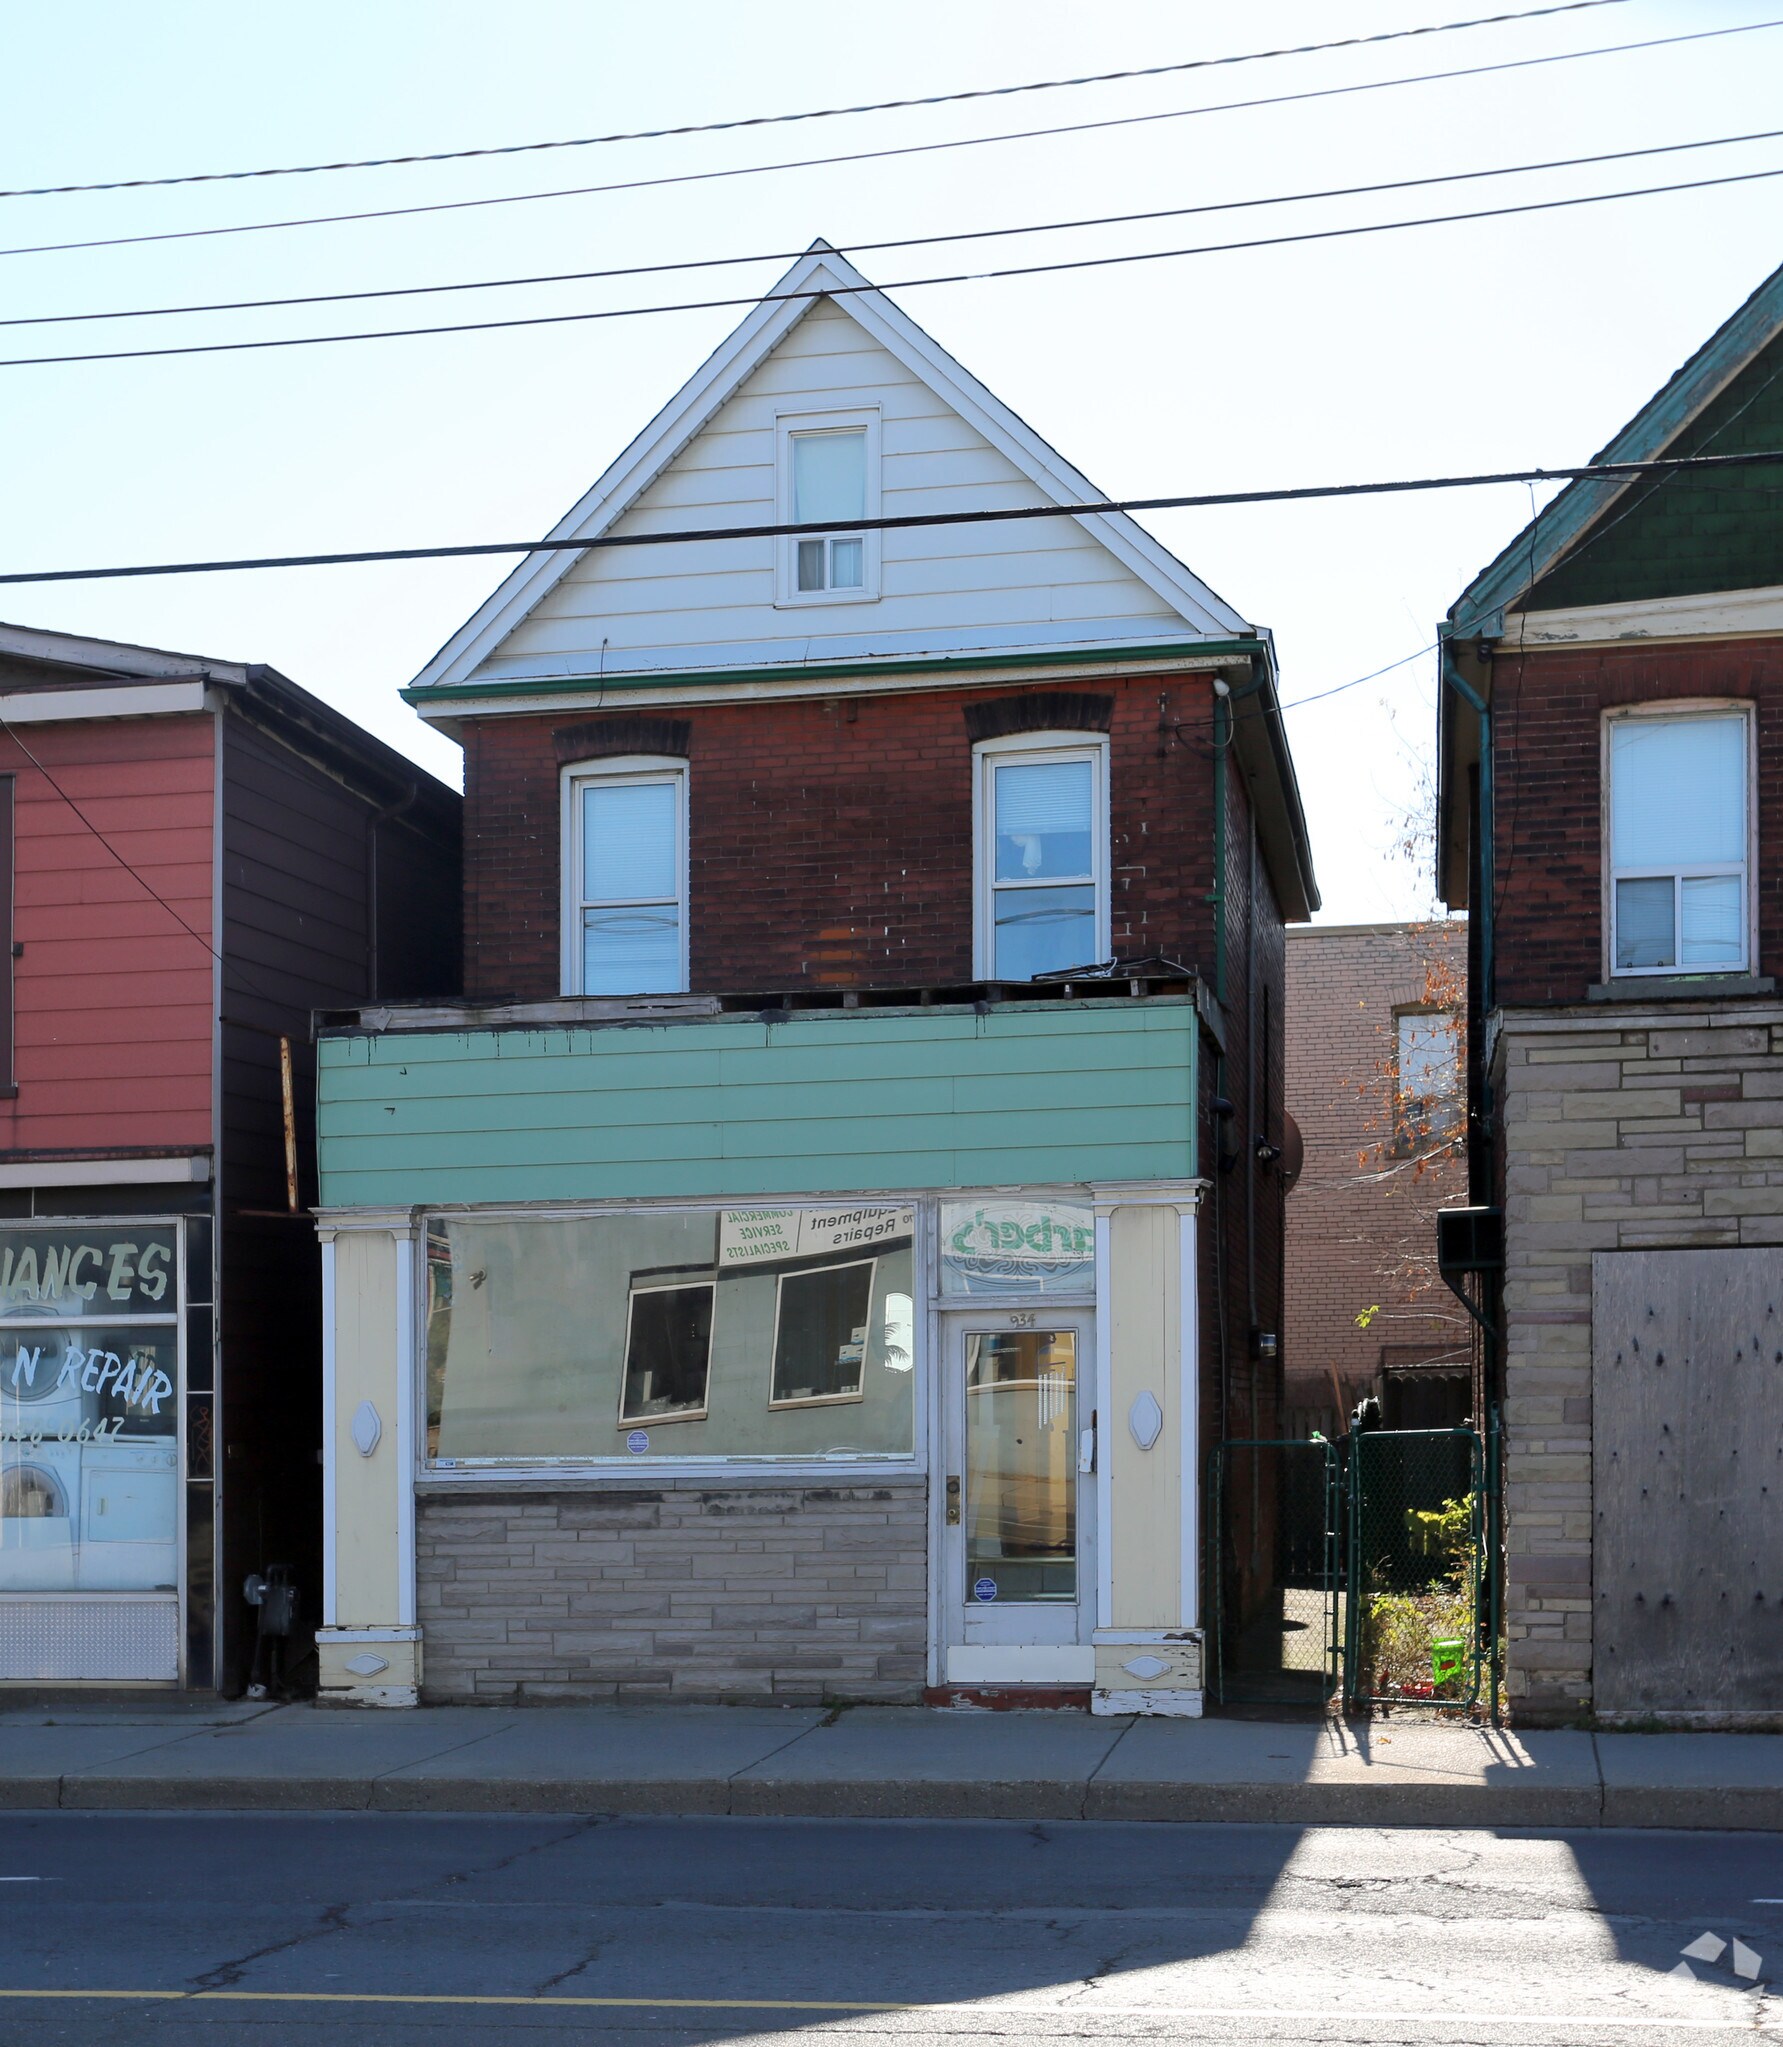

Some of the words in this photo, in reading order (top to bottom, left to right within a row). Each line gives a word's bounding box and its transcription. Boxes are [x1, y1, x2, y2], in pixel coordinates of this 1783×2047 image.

[1, 1242, 171, 1300] IANCES
[1010, 1313, 1036, 1329] 934
[57, 1345, 173, 1413] REPAIR
[57, 1416, 125, 1444] 0647
